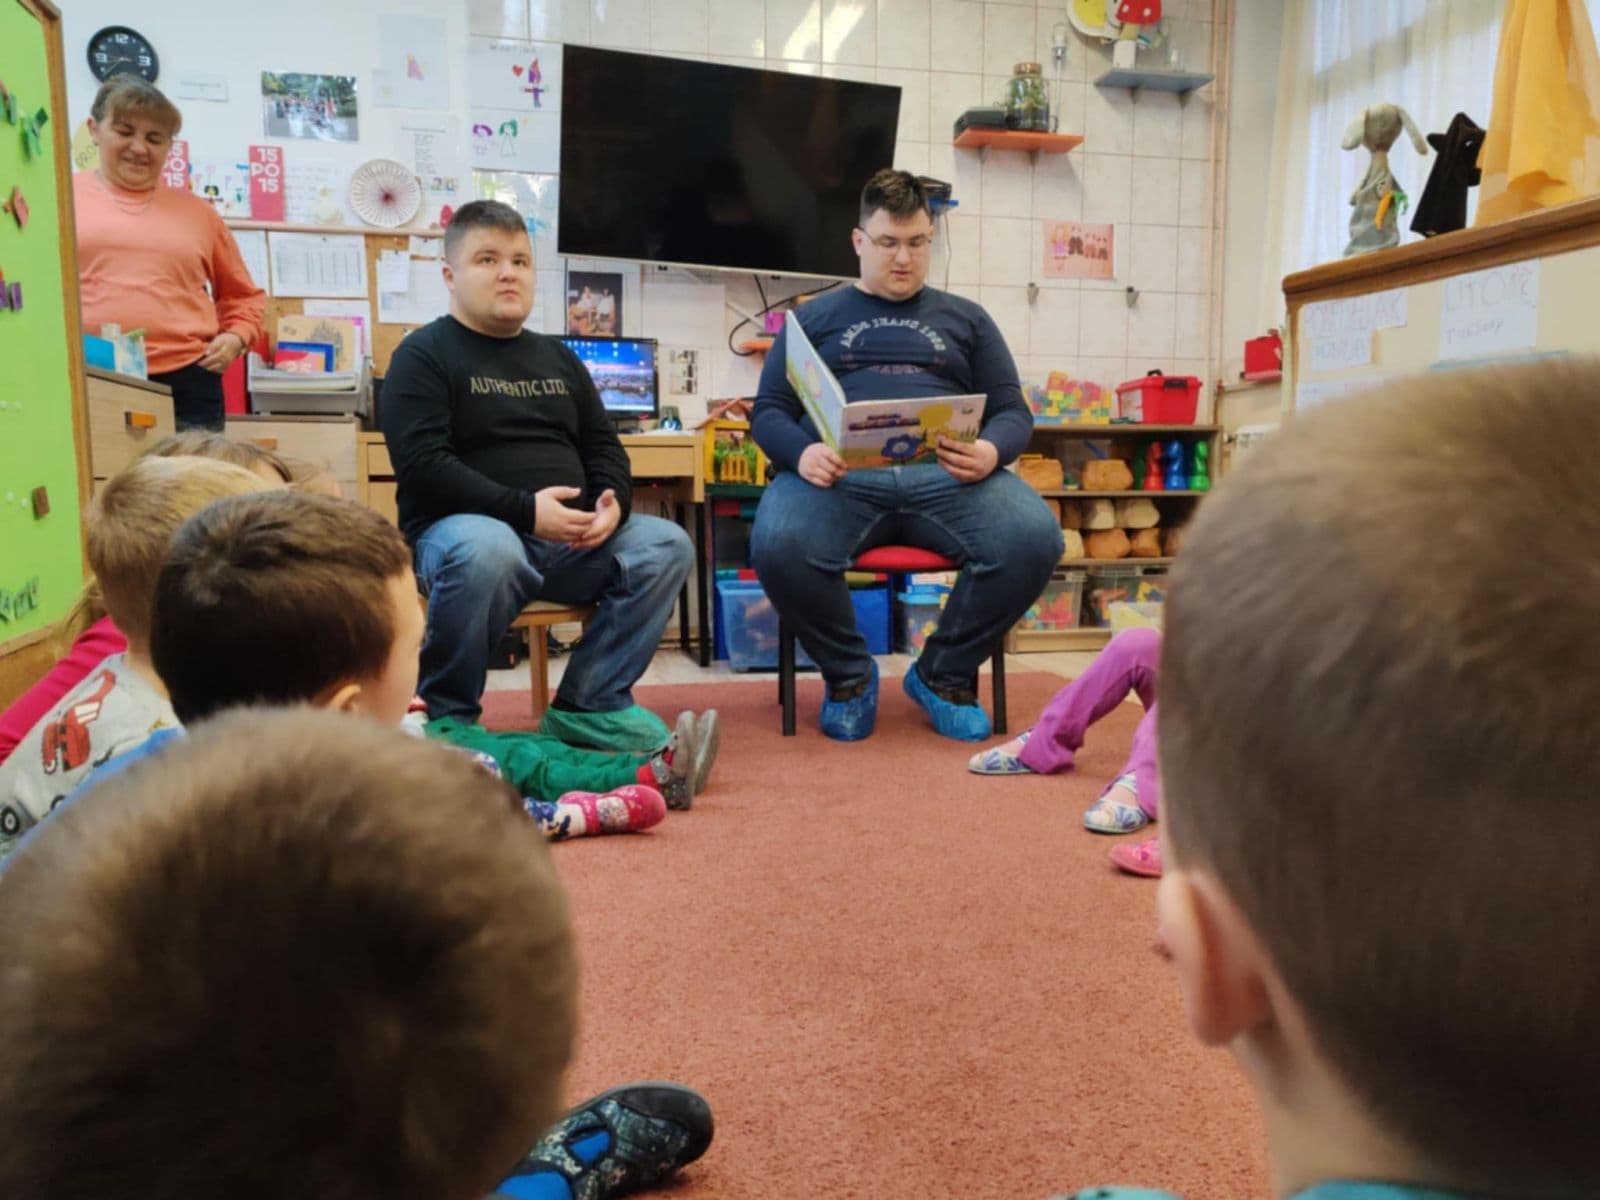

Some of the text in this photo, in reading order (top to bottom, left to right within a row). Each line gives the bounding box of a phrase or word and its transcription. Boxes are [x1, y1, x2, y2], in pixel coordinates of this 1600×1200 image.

[114, 33, 129, 44] 12
[95, 52, 107, 63] 9
[138, 55, 151, 67] 3
[257, 147, 278, 162] 15
[250, 161, 280, 177] PO
[162, 172, 185, 188] 15
[257, 177, 279, 193] 15
[470, 376, 570, 398] AUTHENTIC LTD.
